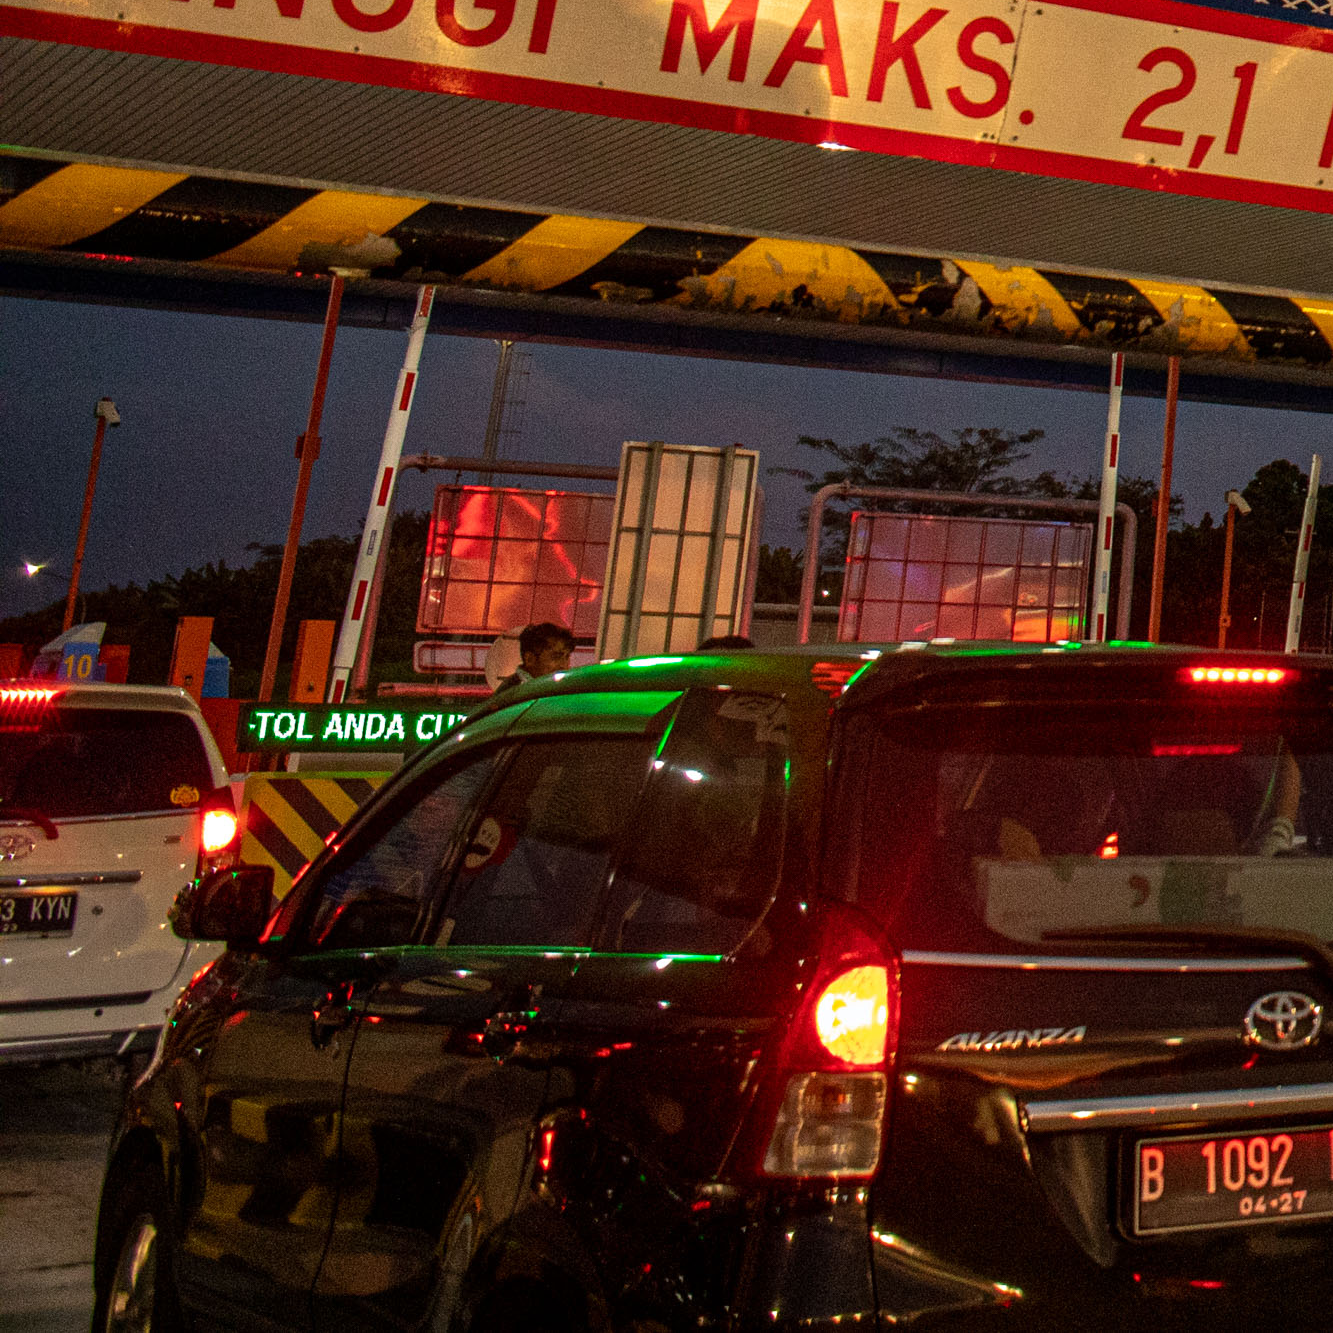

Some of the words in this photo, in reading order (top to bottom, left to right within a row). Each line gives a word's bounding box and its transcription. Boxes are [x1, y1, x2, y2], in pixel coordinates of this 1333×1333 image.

[1122, 47, 1259, 170] 2,1
[63, 654, 93, 679] 10
[322, 712, 406, 741] ANDA
[416, 714, 468, 740] CU
[30, 896, 73, 922] KYN
[935, 1025, 1087, 1053] AVANZA
[1141, 1147, 1165, 1203] B
[1201, 1134, 1294, 1194] 1092
